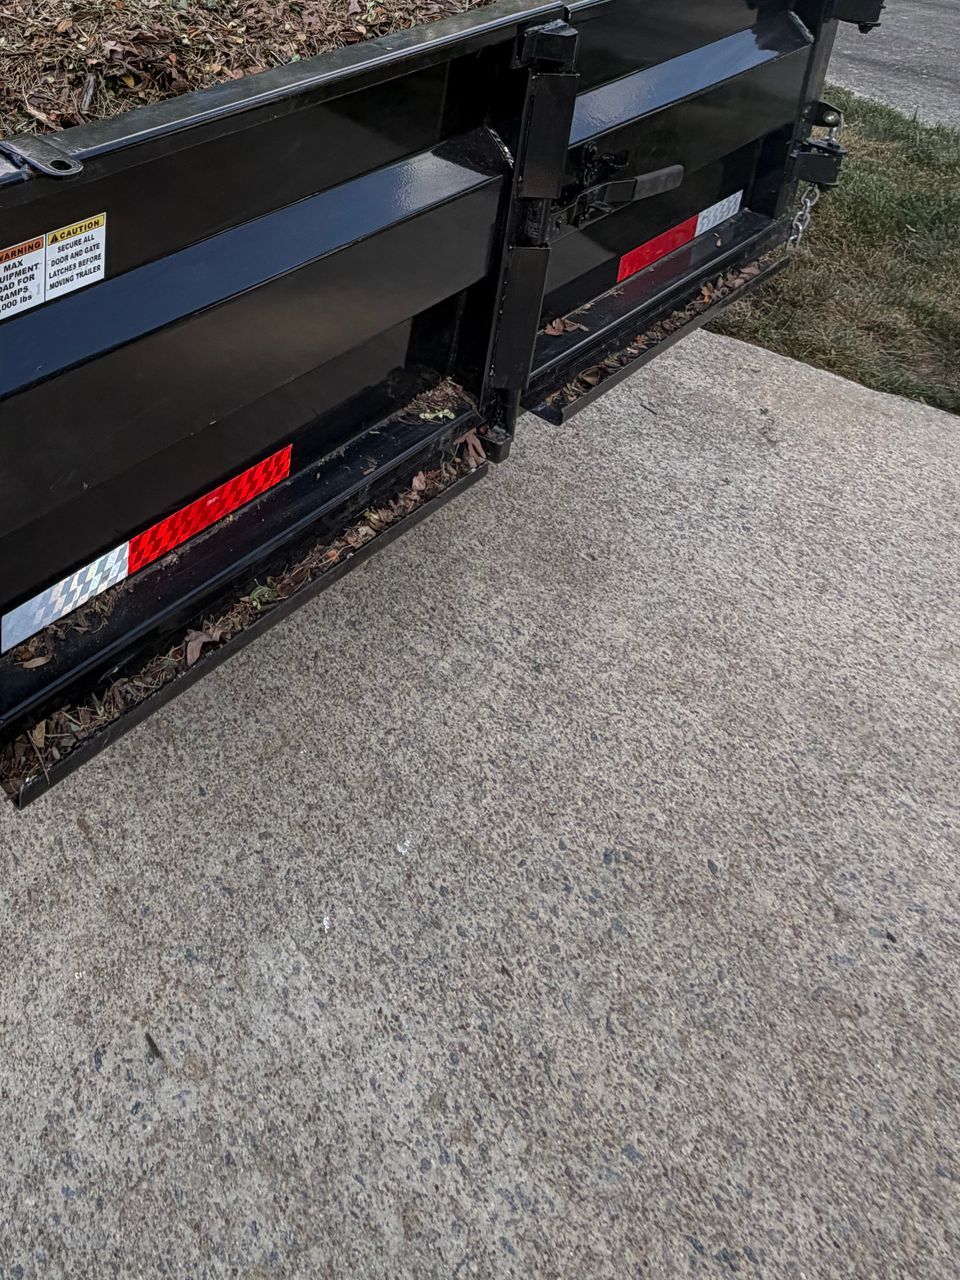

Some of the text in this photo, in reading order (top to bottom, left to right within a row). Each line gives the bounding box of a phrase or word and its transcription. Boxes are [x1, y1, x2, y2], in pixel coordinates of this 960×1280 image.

[59, 219, 100, 240] CAUTION
[57, 233, 95, 253] SECURE ALL
[50, 242, 101, 267] DOOR AND GATE
[3, 259, 24, 273] MAX
[49, 253, 102, 279] LATCHES BEFORE
[17, 273, 35, 286] FOR
[49, 264, 101, 290] MOVING TRAILER
[19, 294, 33, 304] lbs
